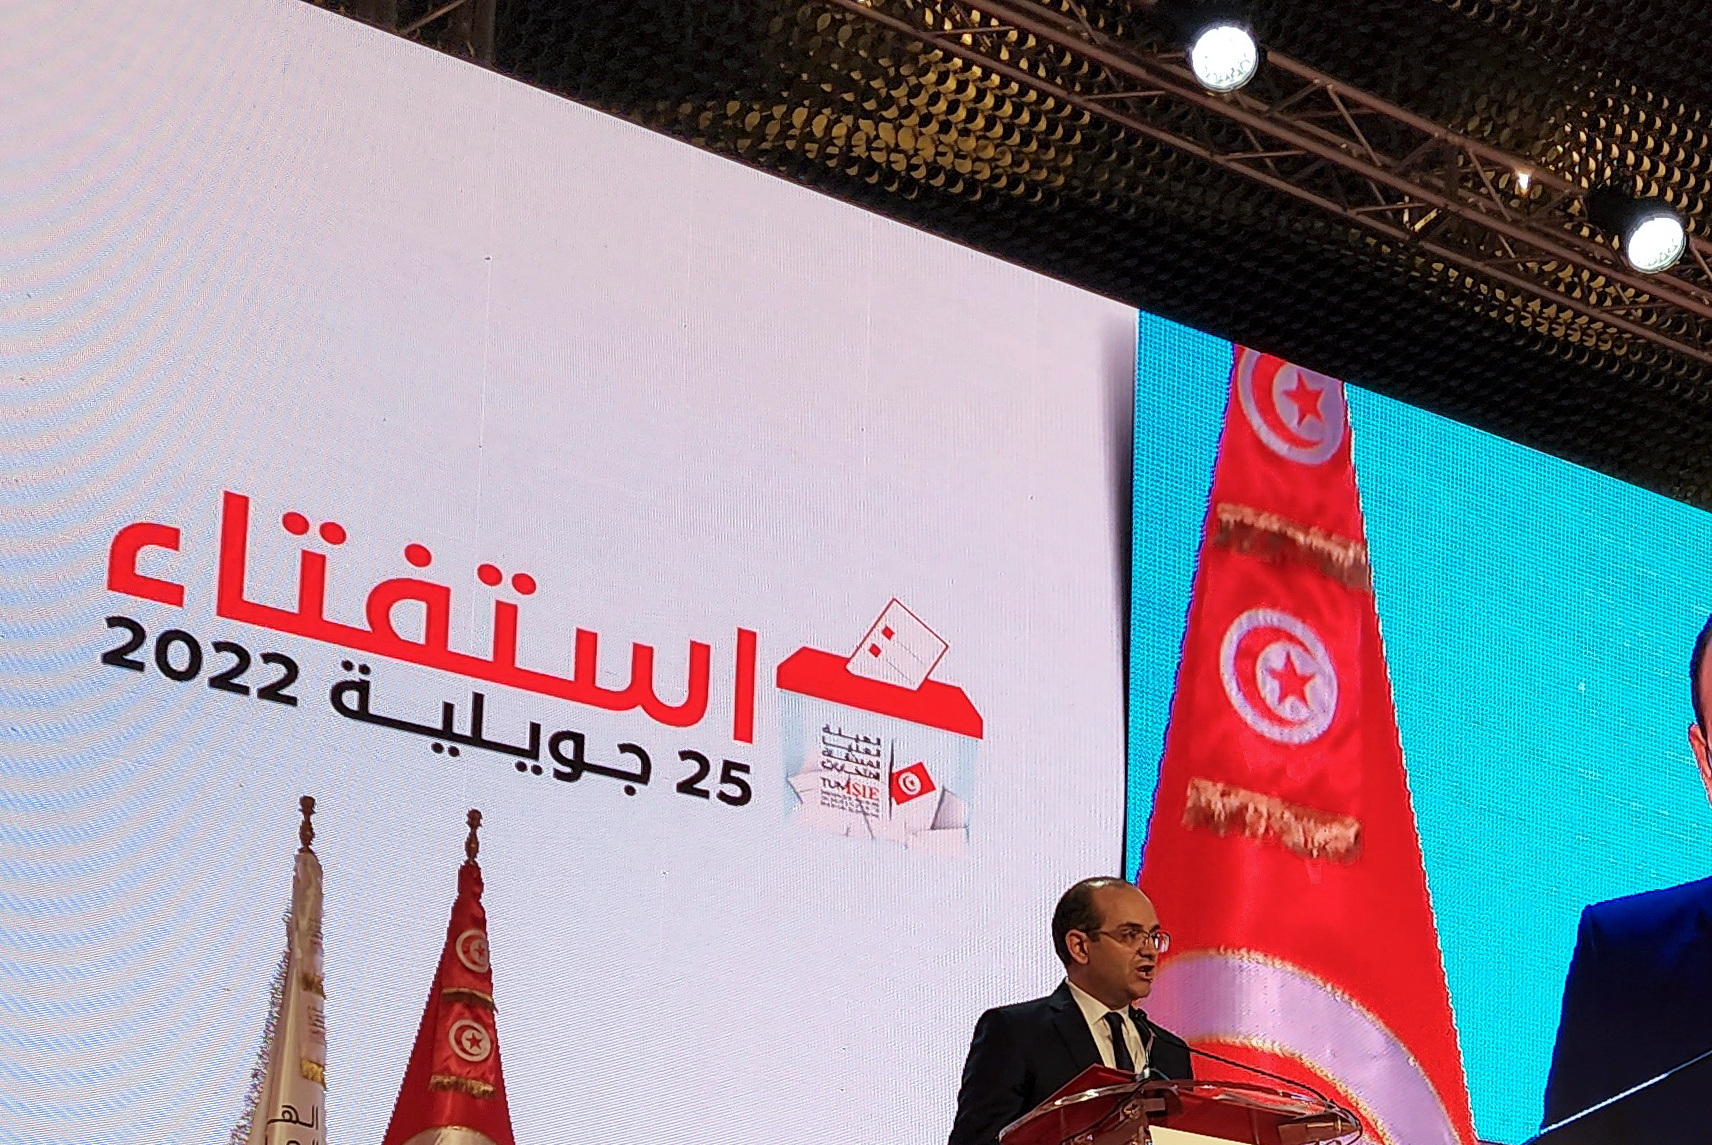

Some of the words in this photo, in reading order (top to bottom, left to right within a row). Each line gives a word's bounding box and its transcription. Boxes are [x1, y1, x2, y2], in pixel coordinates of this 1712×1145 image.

[100, 615, 299, 707] 2022
[106, 490, 756, 744] استفتاء
[329, 660, 651, 796] جويلية
[676, 750, 754, 807] 25
